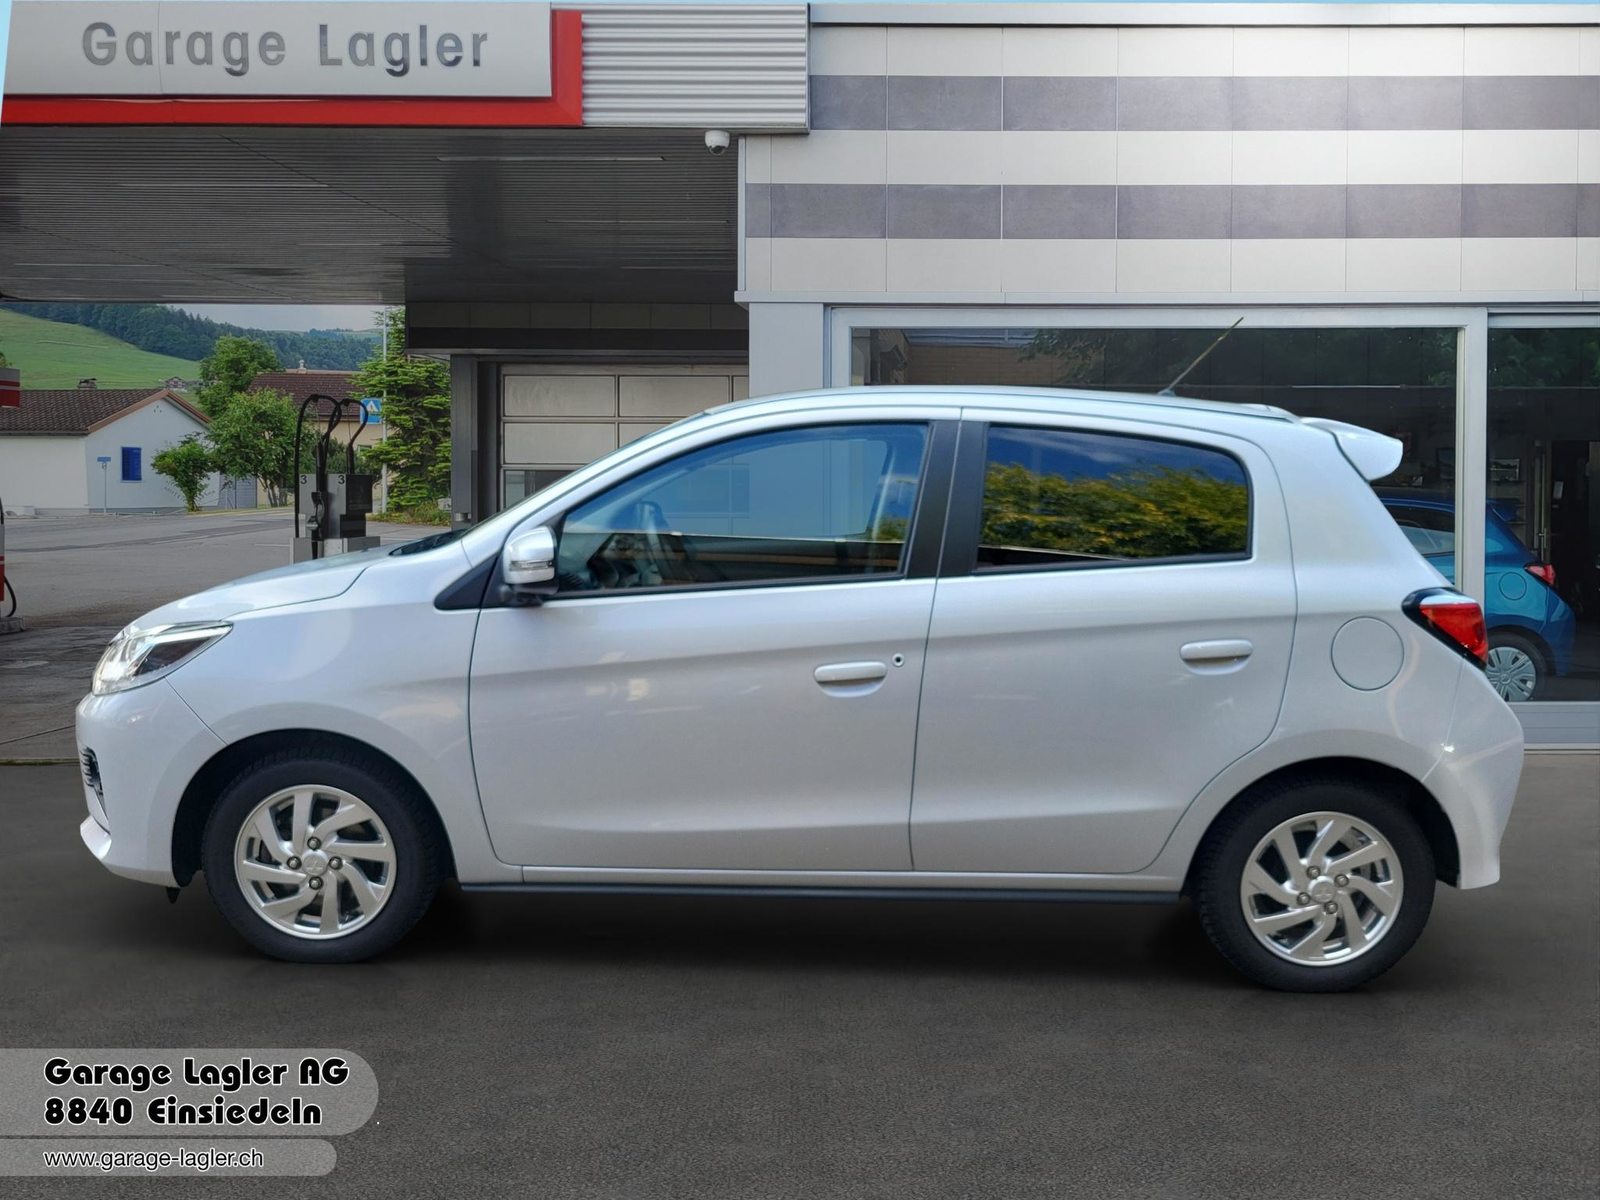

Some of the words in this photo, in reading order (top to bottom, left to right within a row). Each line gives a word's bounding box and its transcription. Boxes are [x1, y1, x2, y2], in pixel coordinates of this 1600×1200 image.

[82, 21, 286, 77] Garage
[318, 23, 489, 77] Lagler
[300, 474, 308, 485] 3
[337, 474, 345, 485] 3
